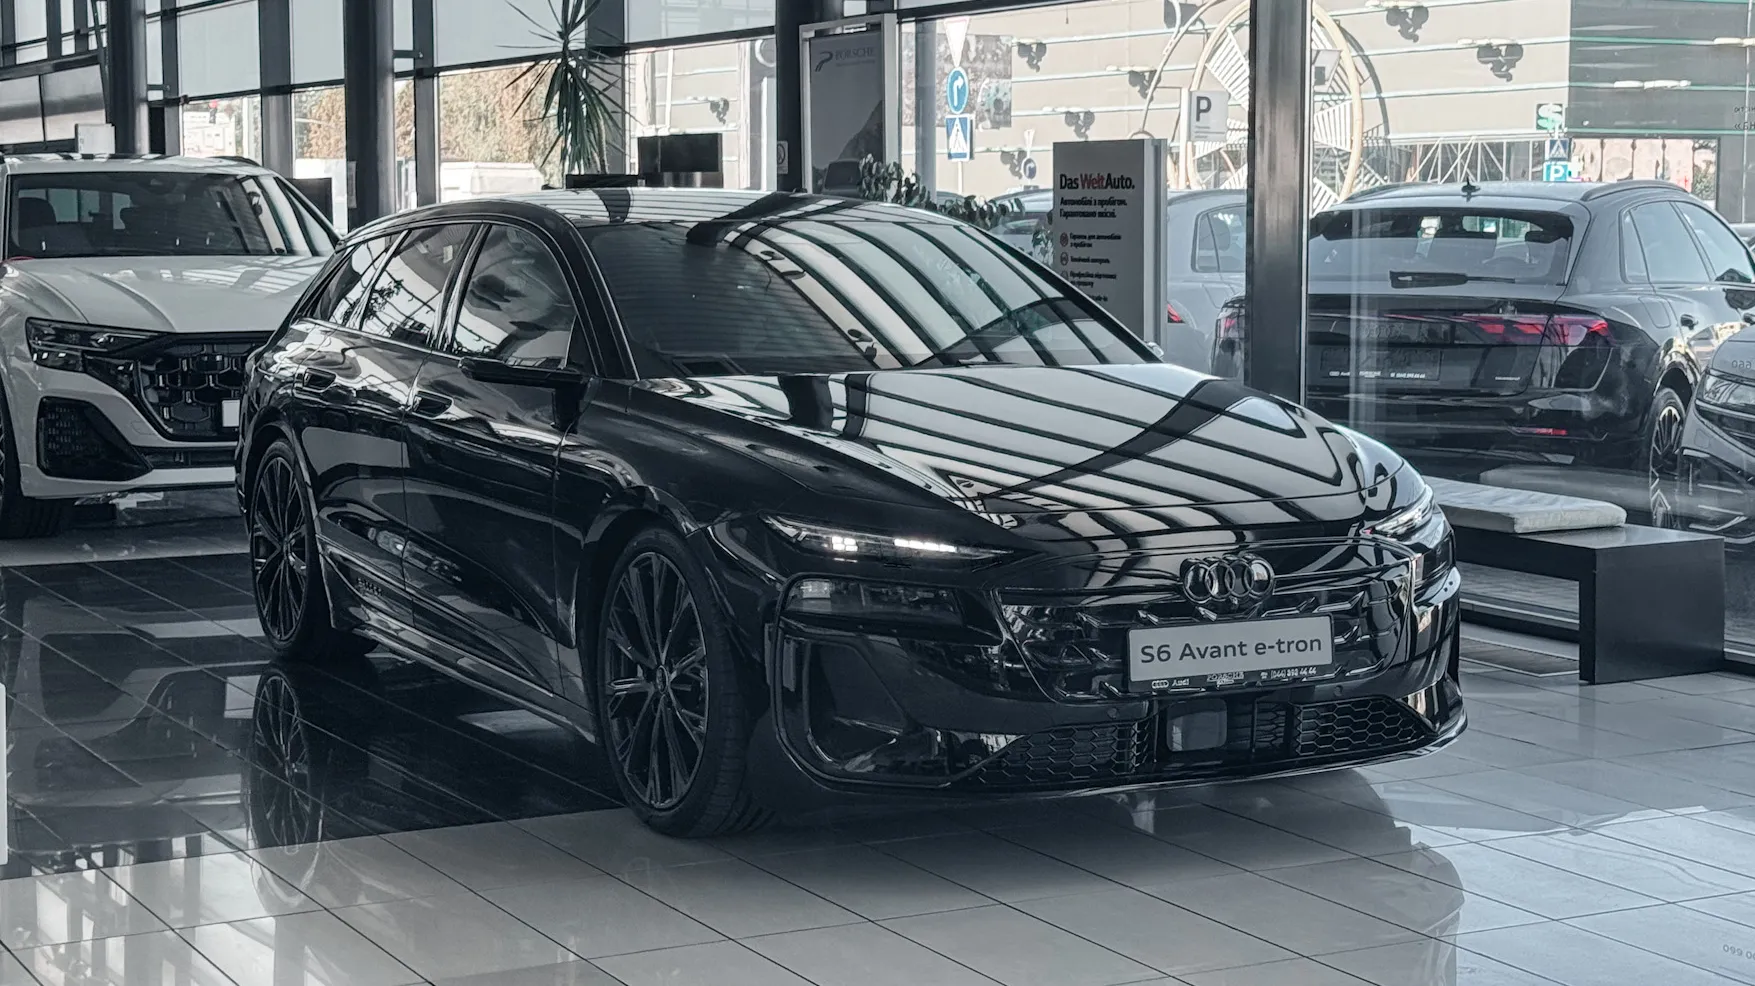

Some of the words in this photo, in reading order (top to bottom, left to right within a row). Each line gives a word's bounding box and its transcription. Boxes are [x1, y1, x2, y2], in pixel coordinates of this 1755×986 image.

[1196, 96, 1212, 122] P
[1059, 173, 1079, 190] Das
[1140, 644, 1172, 664] S6
[1178, 640, 1248, 661] Avant
[1254, 637, 1322, 656] e-tron
[1172, 678, 1190, 687] Audi
